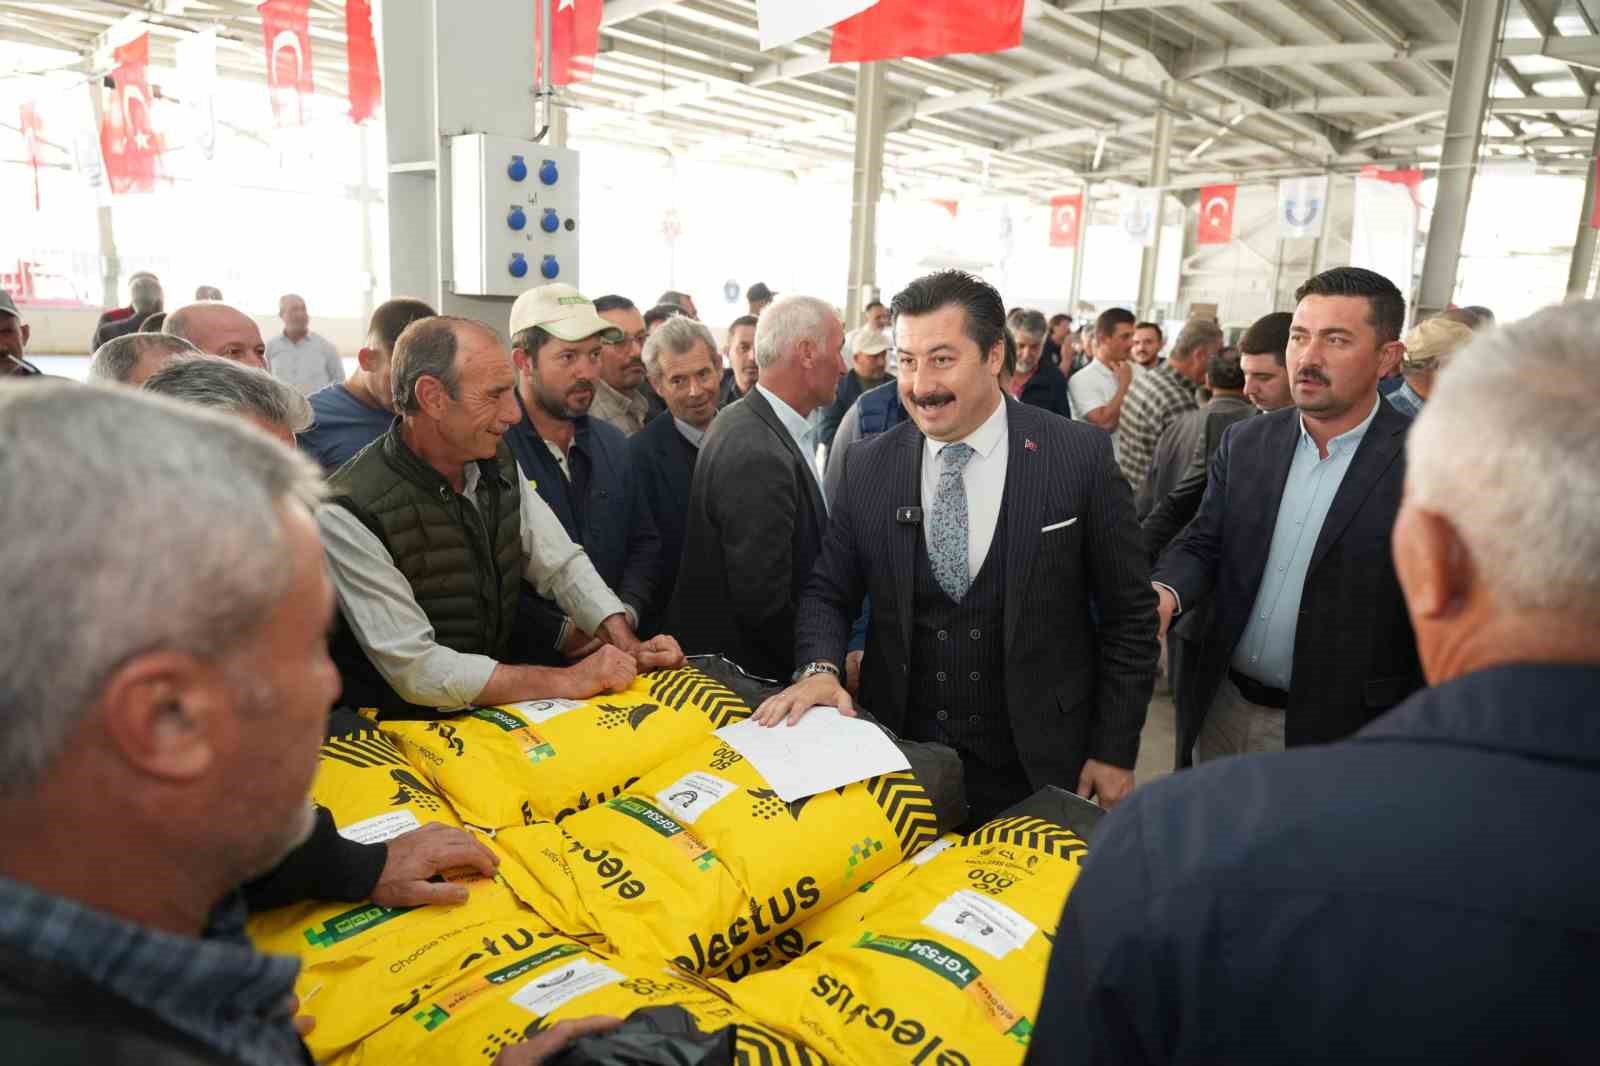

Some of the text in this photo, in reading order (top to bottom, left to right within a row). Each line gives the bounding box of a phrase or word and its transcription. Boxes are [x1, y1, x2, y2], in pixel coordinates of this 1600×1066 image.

[709, 758, 732, 771] 50
[713, 747, 744, 764] 000
[642, 809, 681, 834] TGF534
[967, 868, 1014, 889] 000
[389, 938, 439, 974] Choose
[909, 942, 972, 983] TGF534
